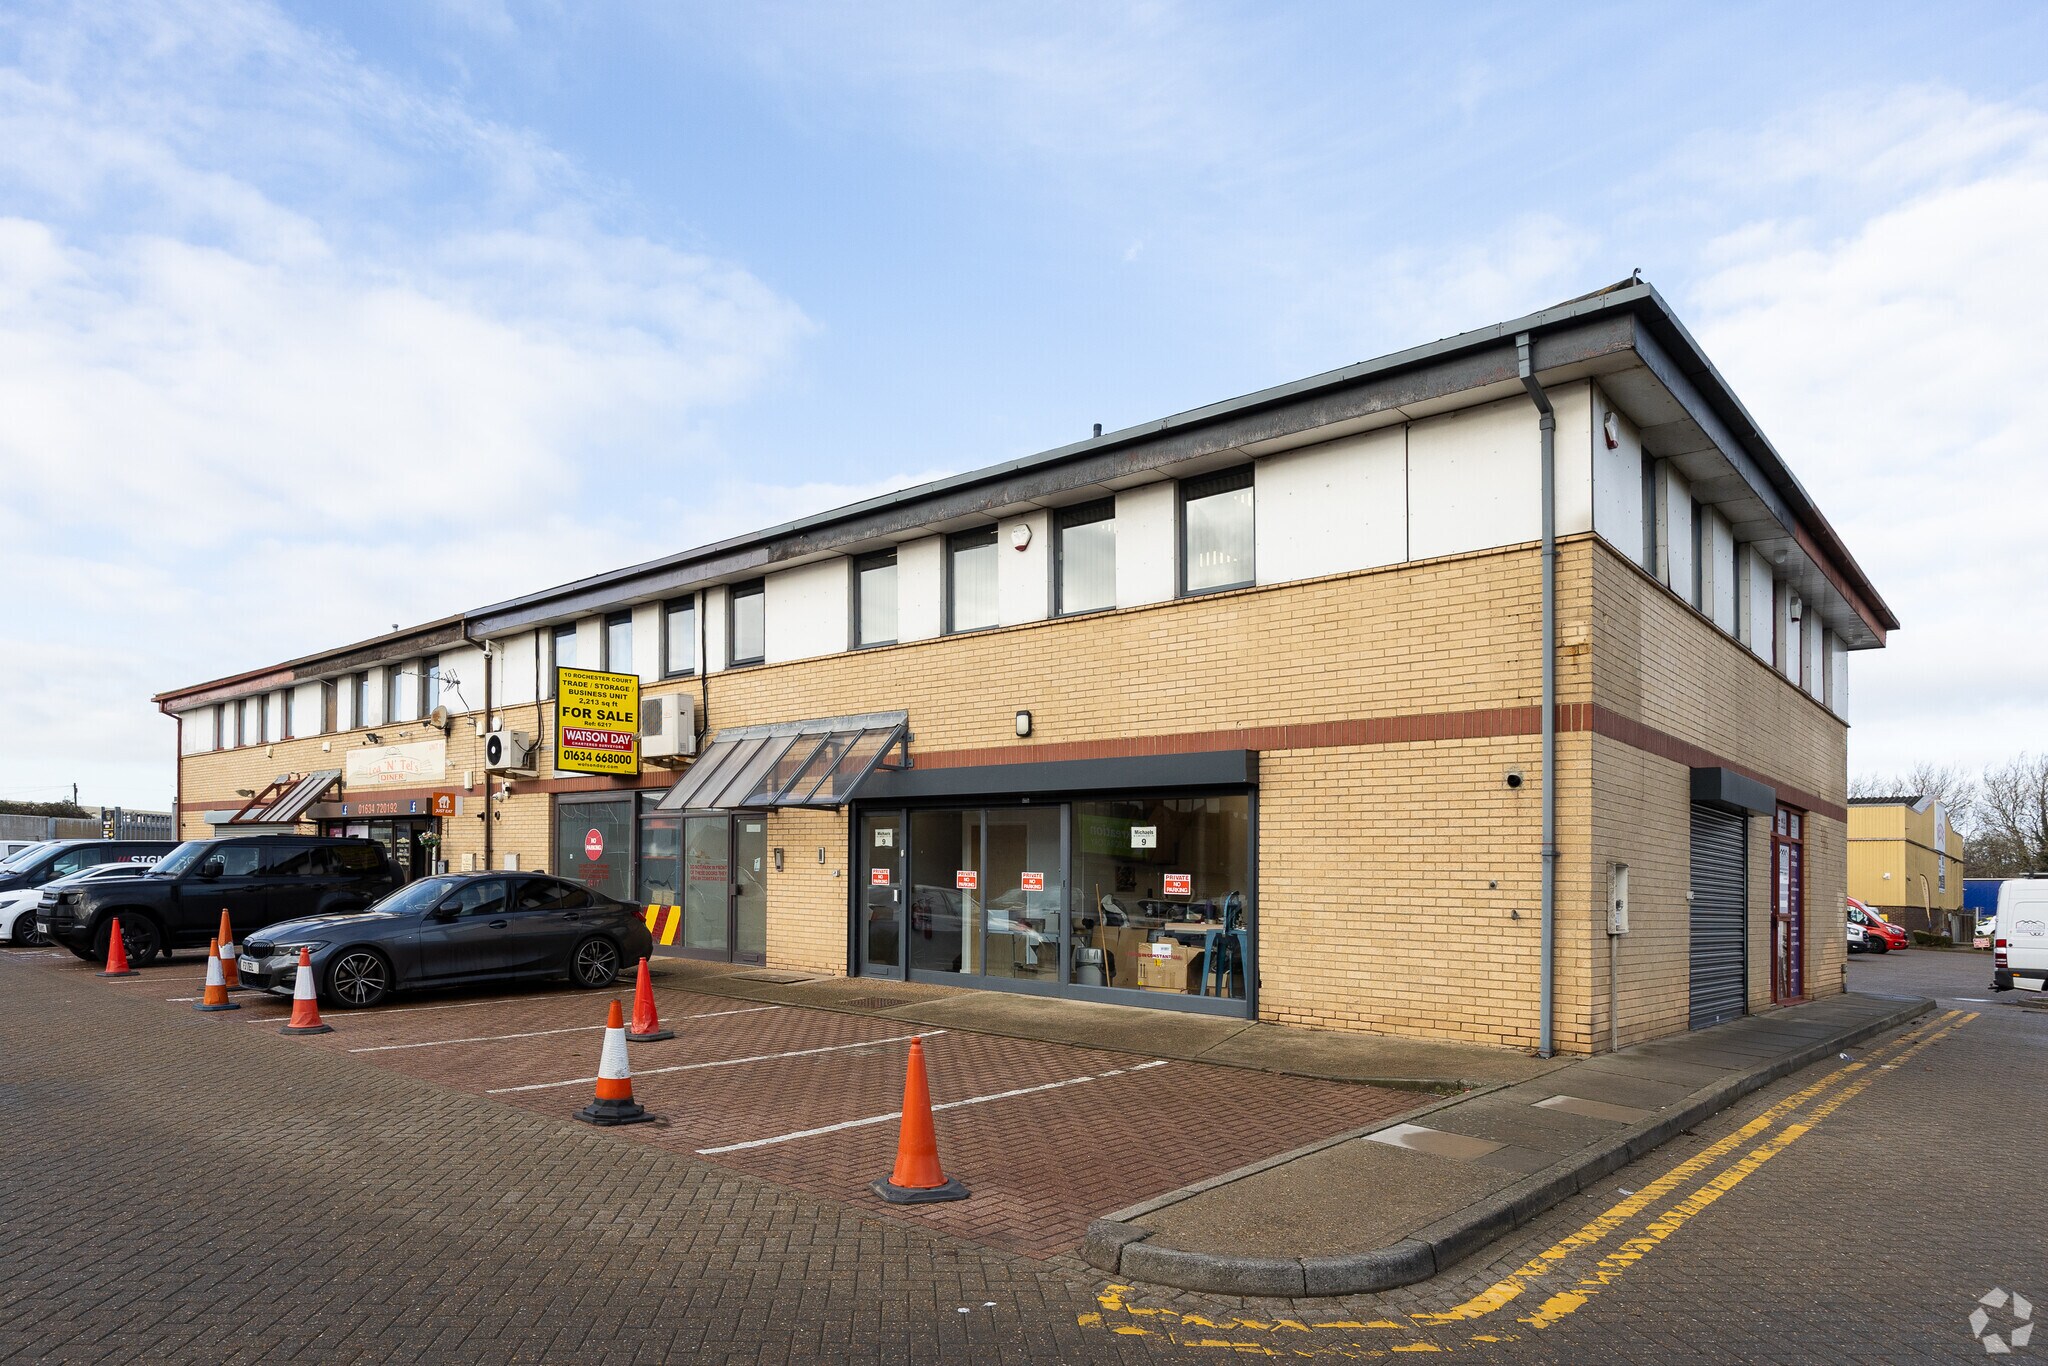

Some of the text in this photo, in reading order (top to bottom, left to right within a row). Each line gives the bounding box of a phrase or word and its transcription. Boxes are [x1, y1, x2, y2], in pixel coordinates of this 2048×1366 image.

[573, 673, 611, 682] ROCHESTER
[562, 680, 588, 688] TRADE
[594, 683, 630, 692] STORAGE
[568, 689, 628, 700] BUSINESS UNIT
[562, 706, 633, 723] FOR SALE
[565, 729, 631, 745] WATSON DAY
[563, 750, 632, 765] 01634 668000
[380, 773, 404, 781] DINER
[358, 802, 398, 814] 01634 720192
[1141, 838, 1147, 846] 9
